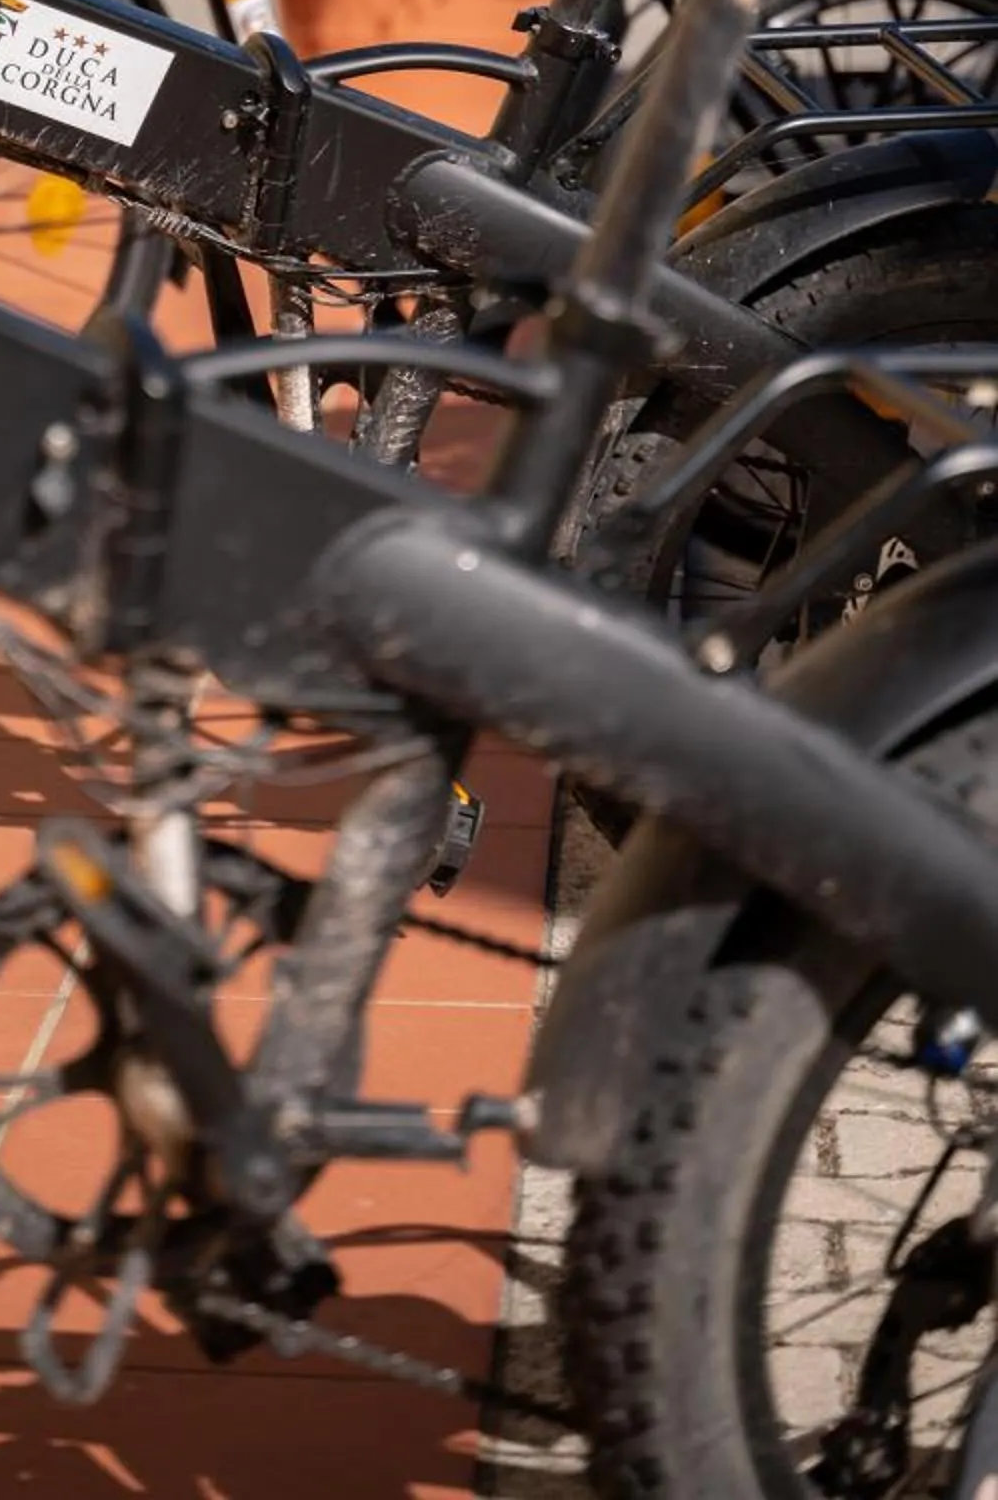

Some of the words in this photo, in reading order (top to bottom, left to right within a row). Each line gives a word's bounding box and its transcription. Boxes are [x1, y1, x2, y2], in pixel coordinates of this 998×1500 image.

[28, 37, 117, 86] DUCA
[42, 63, 92, 91] DELLA
[1, 63, 116, 121] CORGNA
